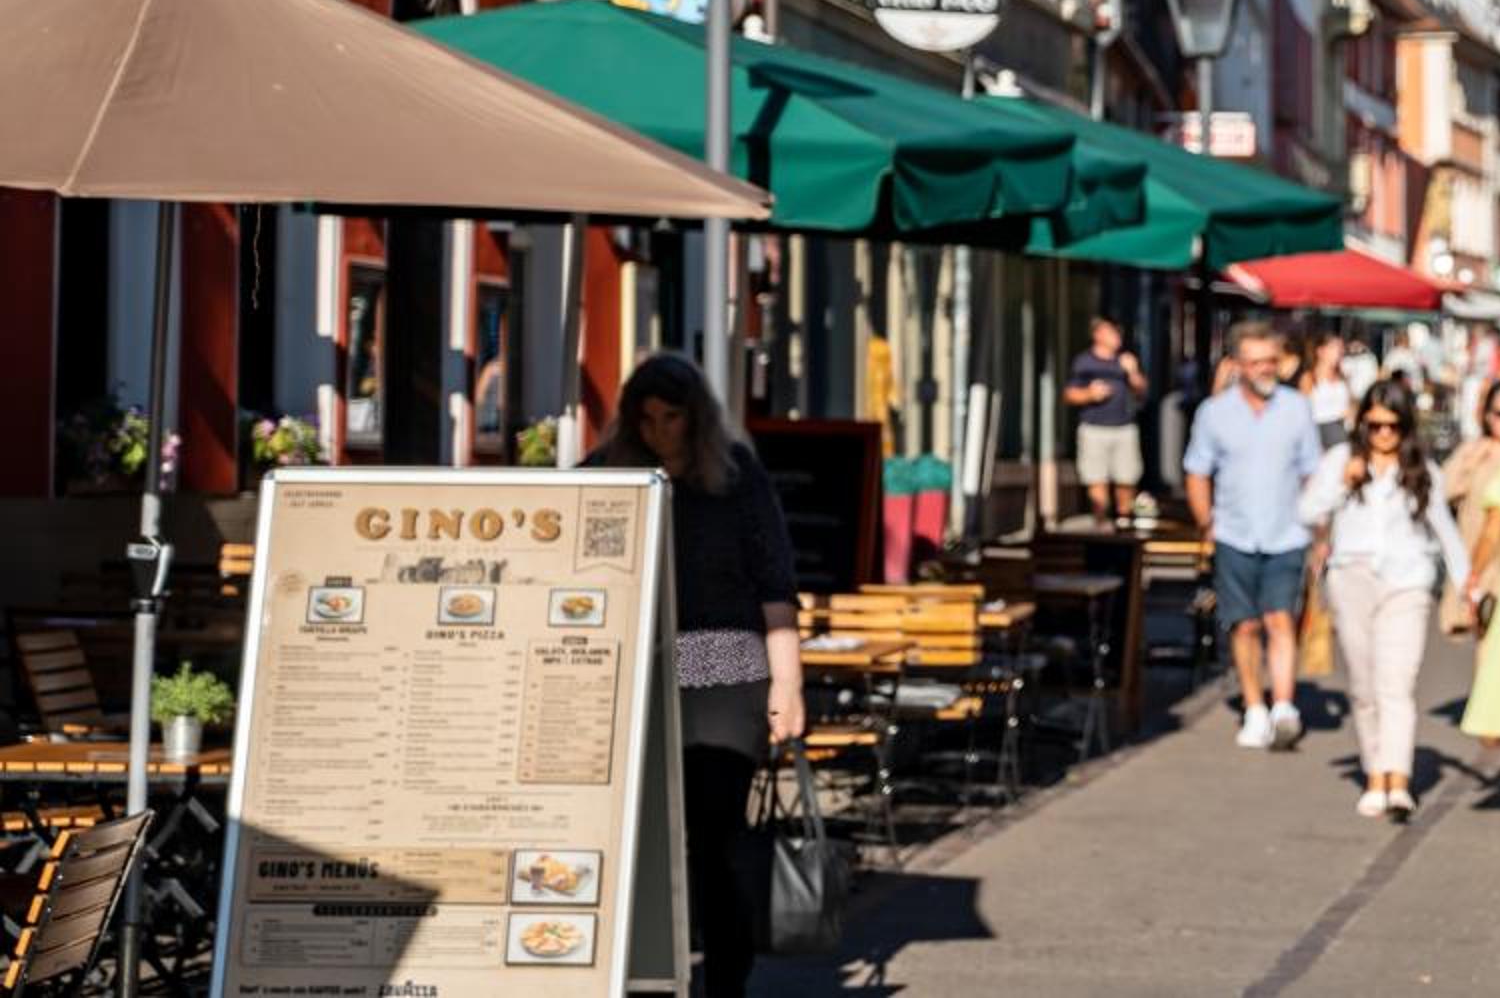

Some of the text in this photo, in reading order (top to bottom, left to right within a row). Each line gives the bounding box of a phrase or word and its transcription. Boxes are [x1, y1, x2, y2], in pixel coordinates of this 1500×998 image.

[354, 507, 562, 542] GINO'S
[258, 857, 380, 878] GINO'S MENÜS
